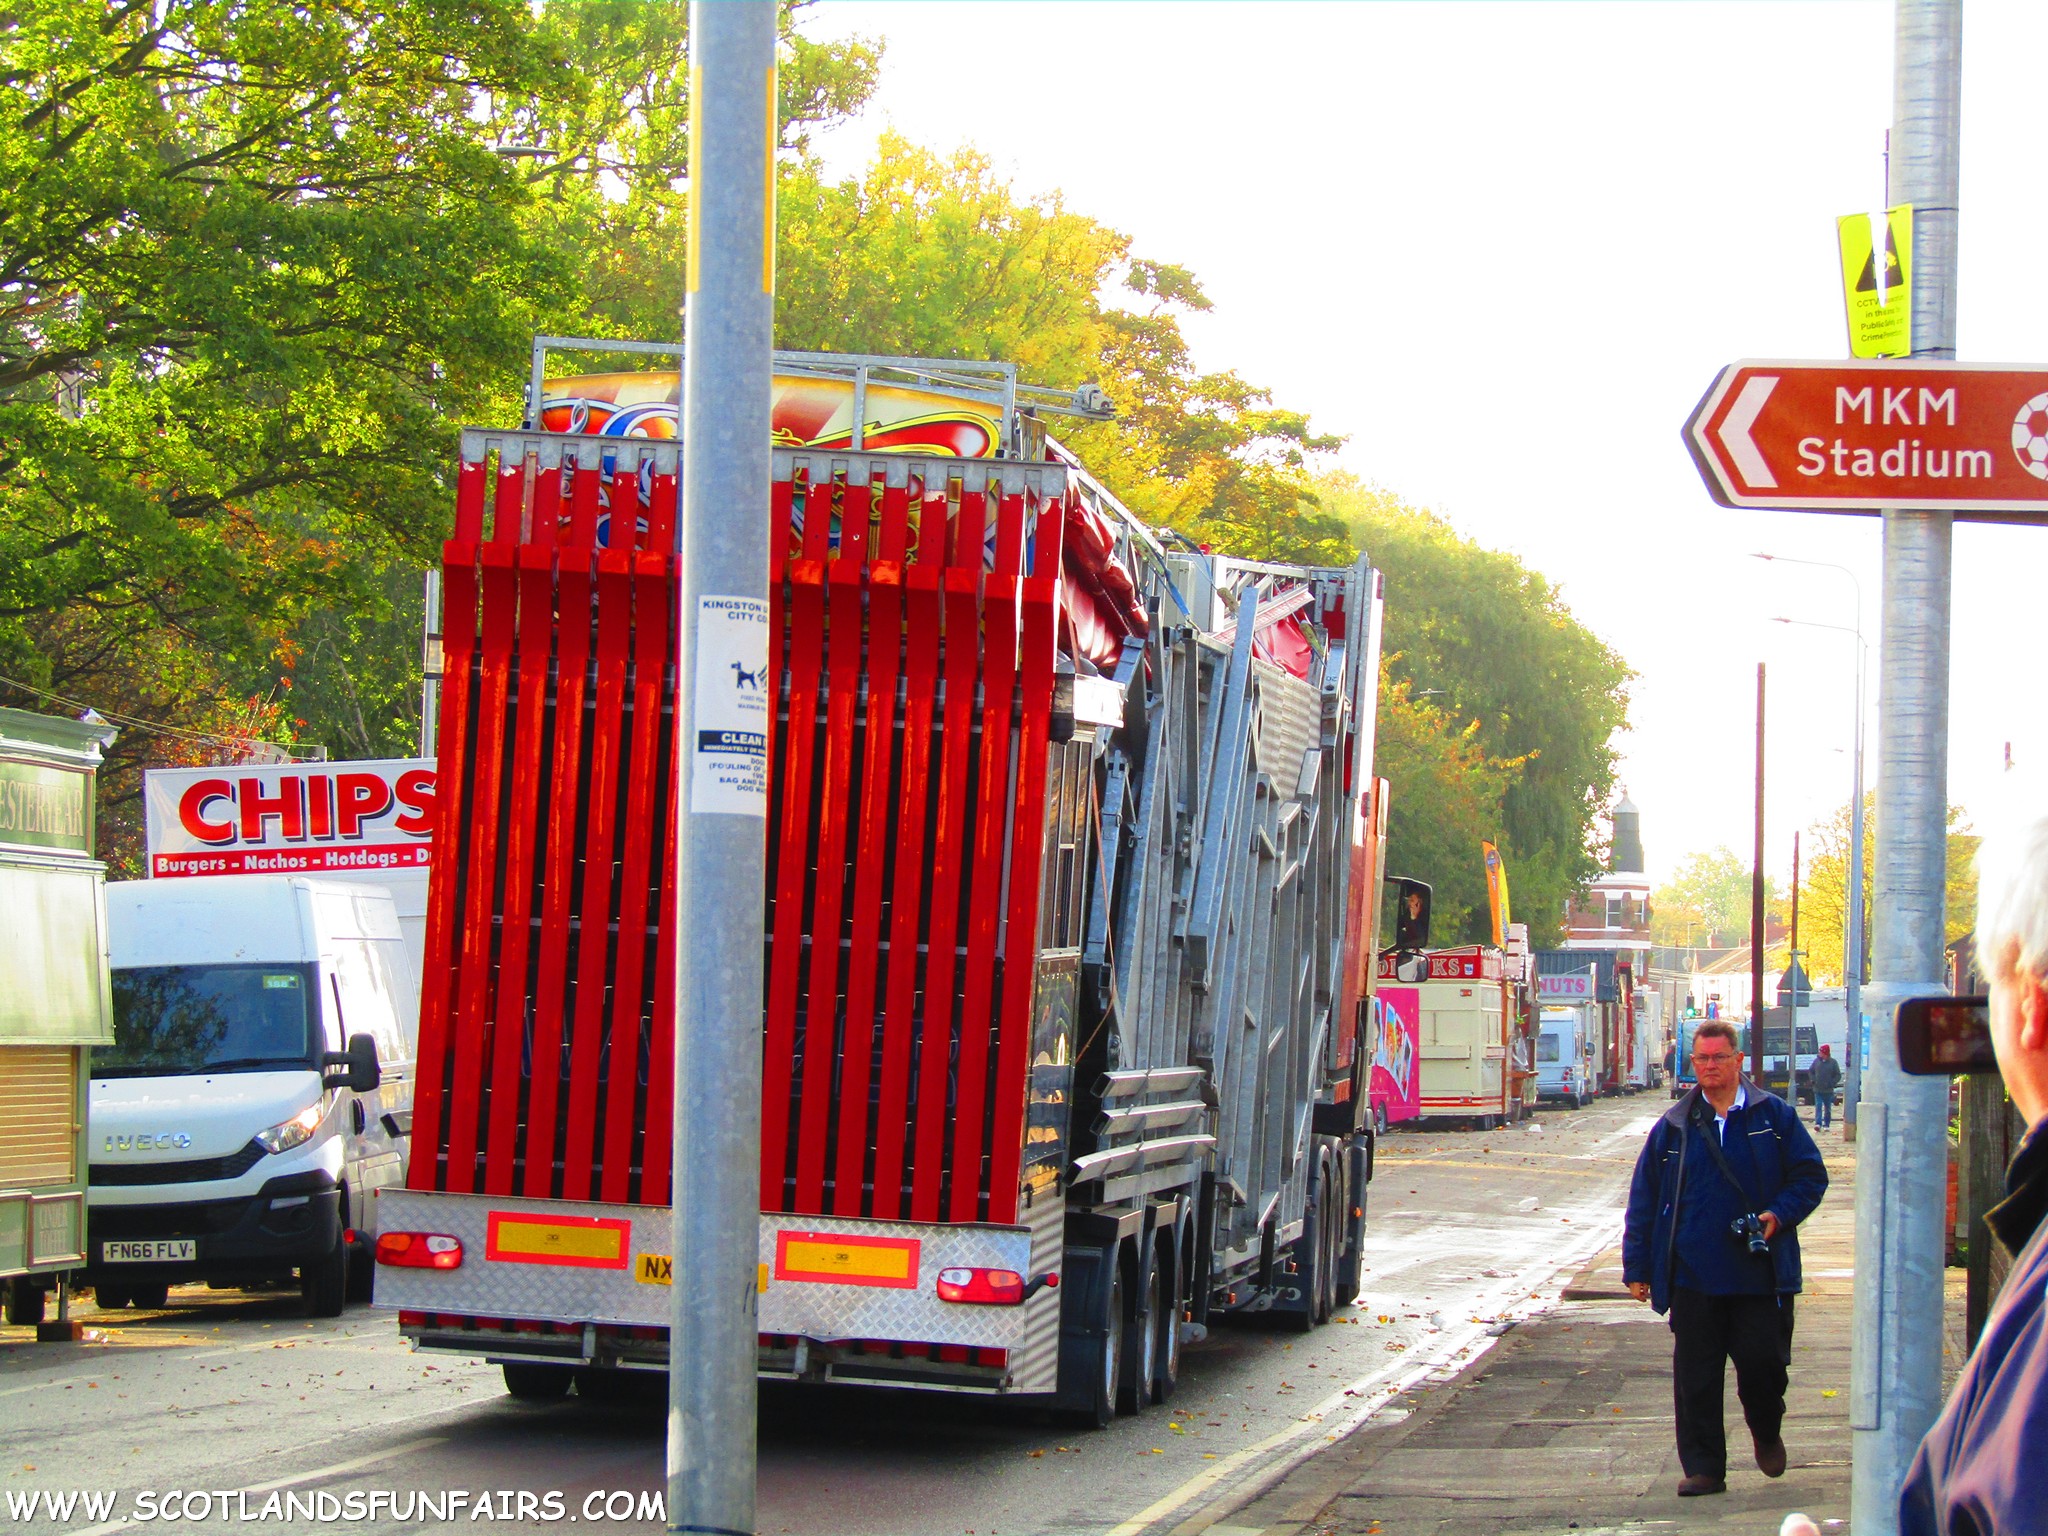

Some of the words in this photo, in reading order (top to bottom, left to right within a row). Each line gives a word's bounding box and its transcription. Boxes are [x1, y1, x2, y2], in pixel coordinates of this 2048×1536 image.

[1835, 386, 1956, 426] MKM
[1796, 437, 1992, 478] Stadium
[703, 600, 761, 611] KINGSTON
[728, 611, 754, 621] CITY
[721, 733, 762, 746] CLEAN
[178, 769, 437, 847] CHIPS
[157, 857, 226, 874] Burgers
[245, 854, 307, 870] Nachos
[325, 849, 398, 867] Hotdogs
[105, 1131, 191, 1152] IVECO
[110, 1243, 153, 1259] FN66
[157, 1242, 189, 1258] FLV
